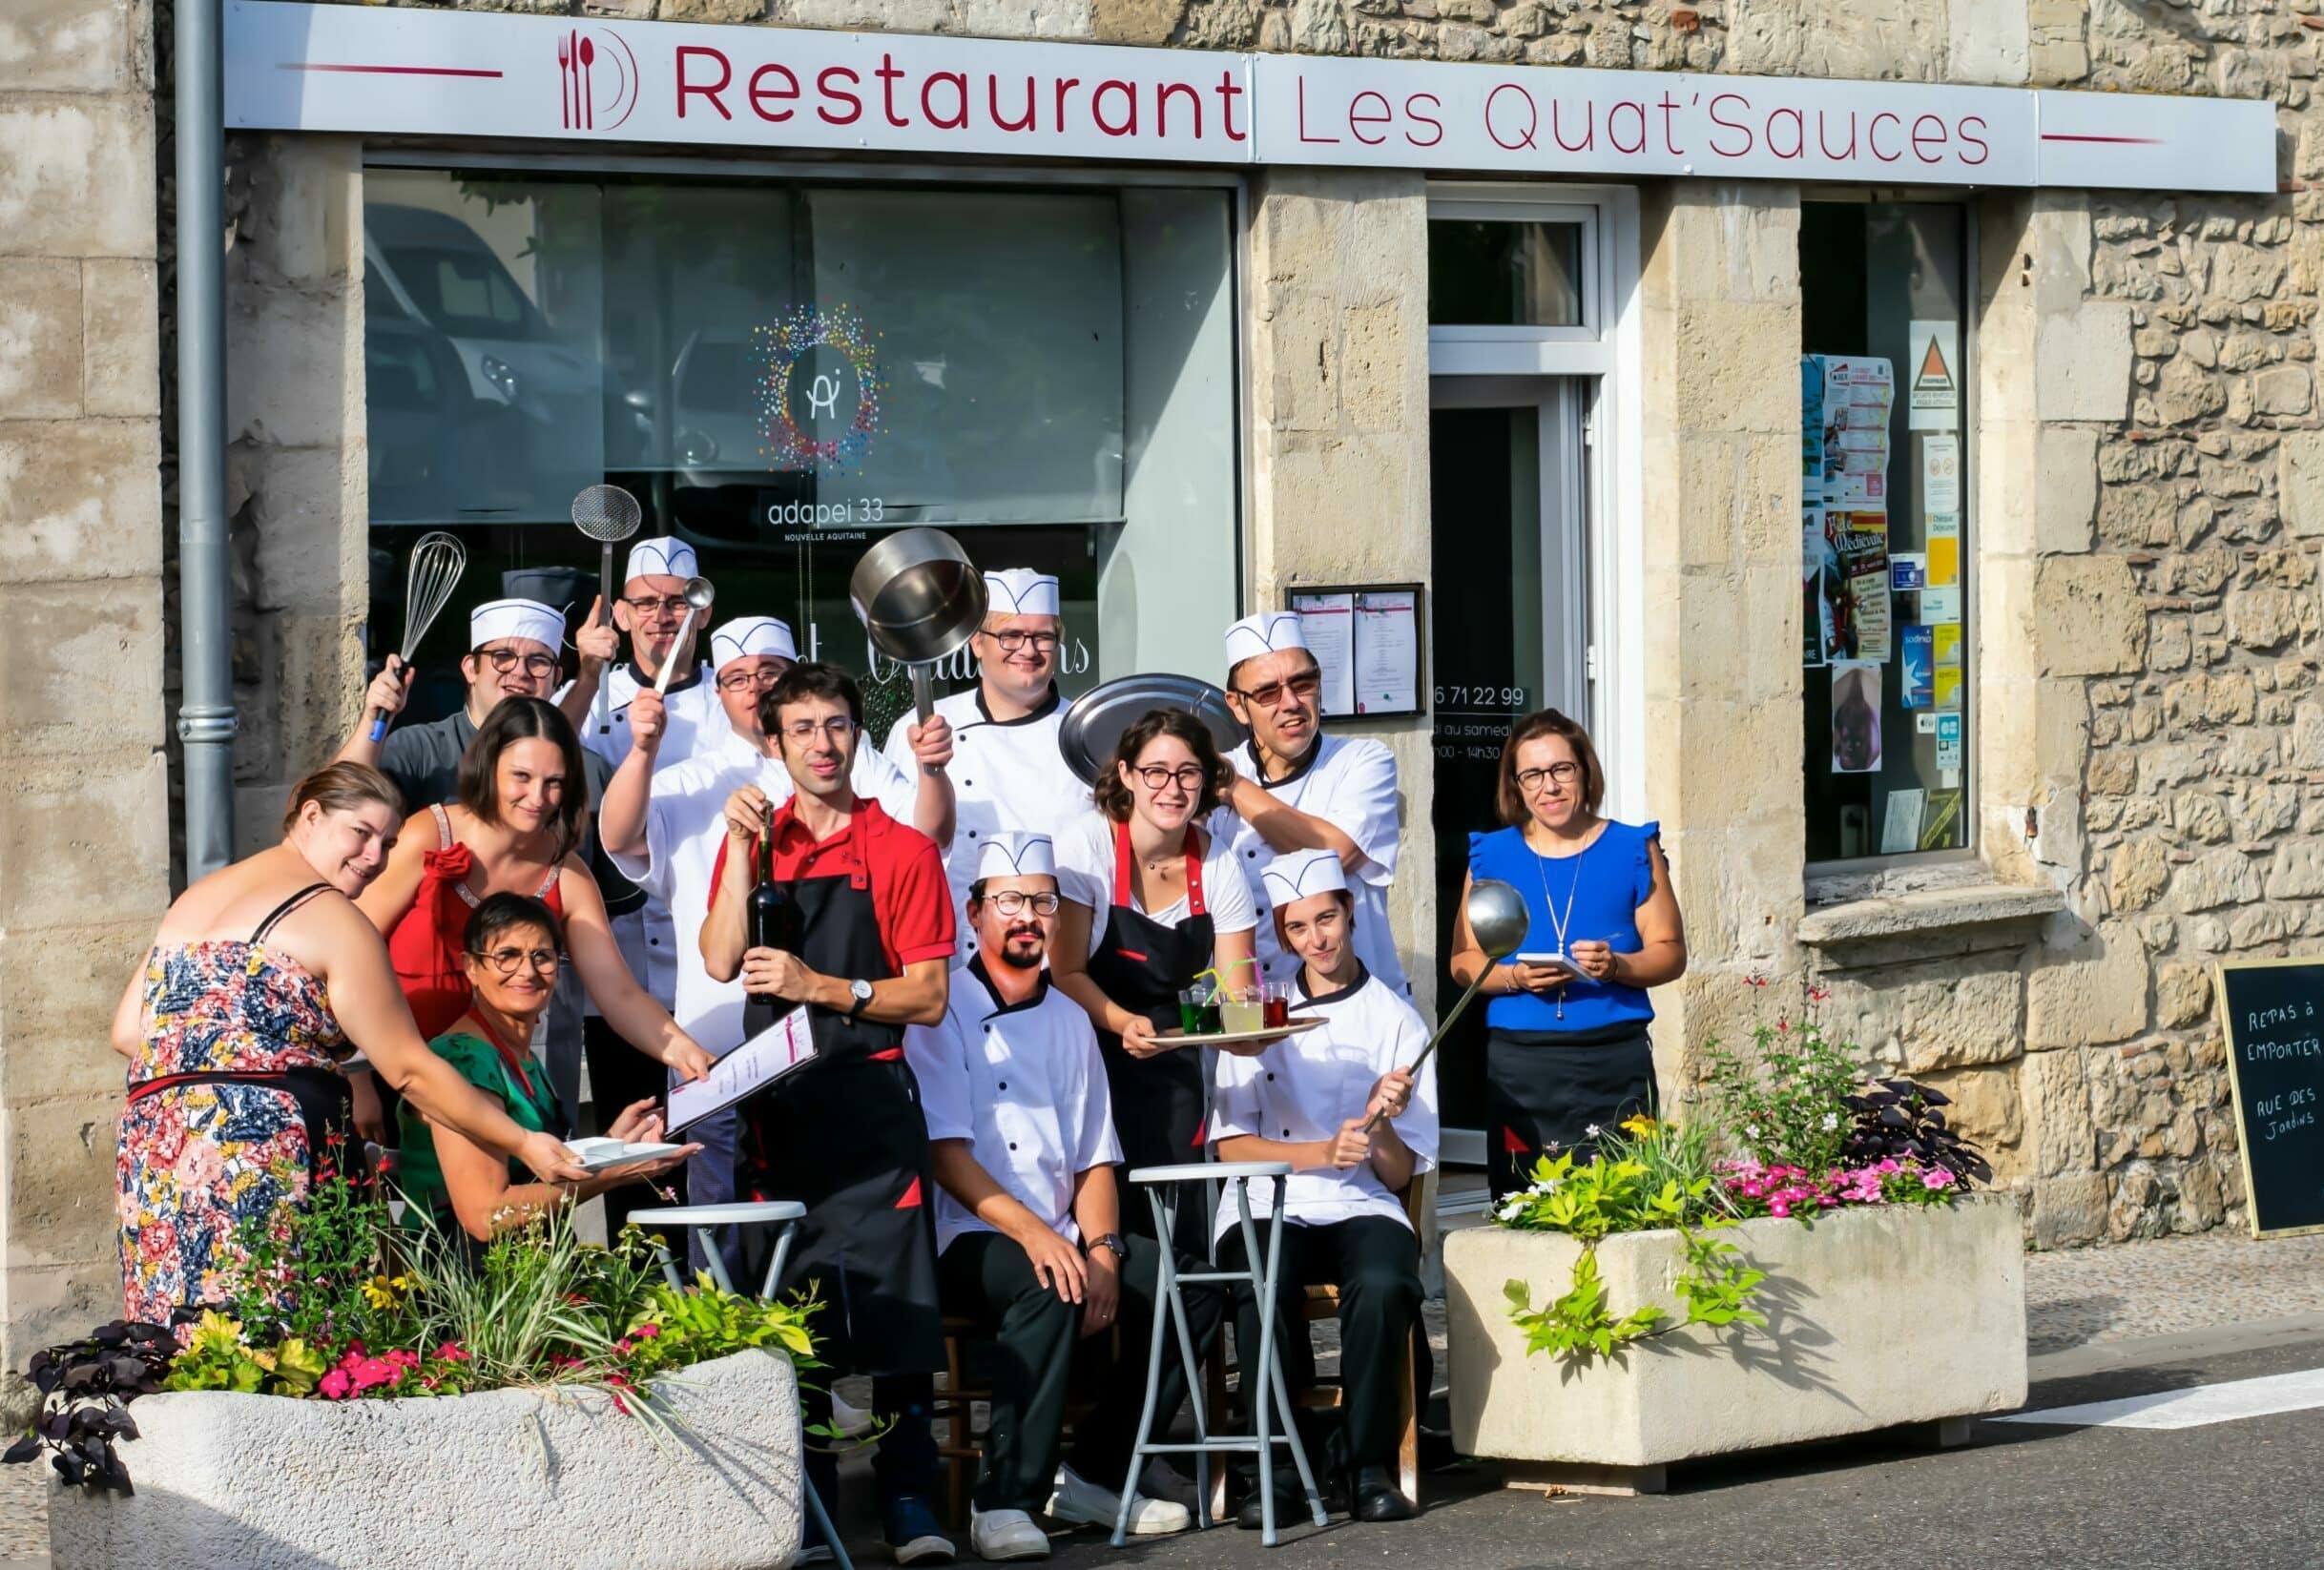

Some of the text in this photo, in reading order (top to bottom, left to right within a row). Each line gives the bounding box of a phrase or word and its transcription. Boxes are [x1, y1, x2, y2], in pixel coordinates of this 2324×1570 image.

[675, 45, 1990, 165] Restaurant Les Quat'Sauces
[767, 497, 883, 529] adapei 33
[784, 531, 867, 543] NOUVELLE AQUITAINE
[1450, 686, 1467, 705] 71
[1473, 686, 1496, 705] 22
[1501, 687, 1524, 706] 99
[1444, 725, 1462, 735] au
[1464, 724, 1512, 736] samedi
[1466, 747, 1501, 759] 14h30
[2249, 1004, 2296, 1032] REPAS
[2247, 1038, 2321, 1061] EMPORTER
[2257, 1087, 2315, 1117] RUE DES
